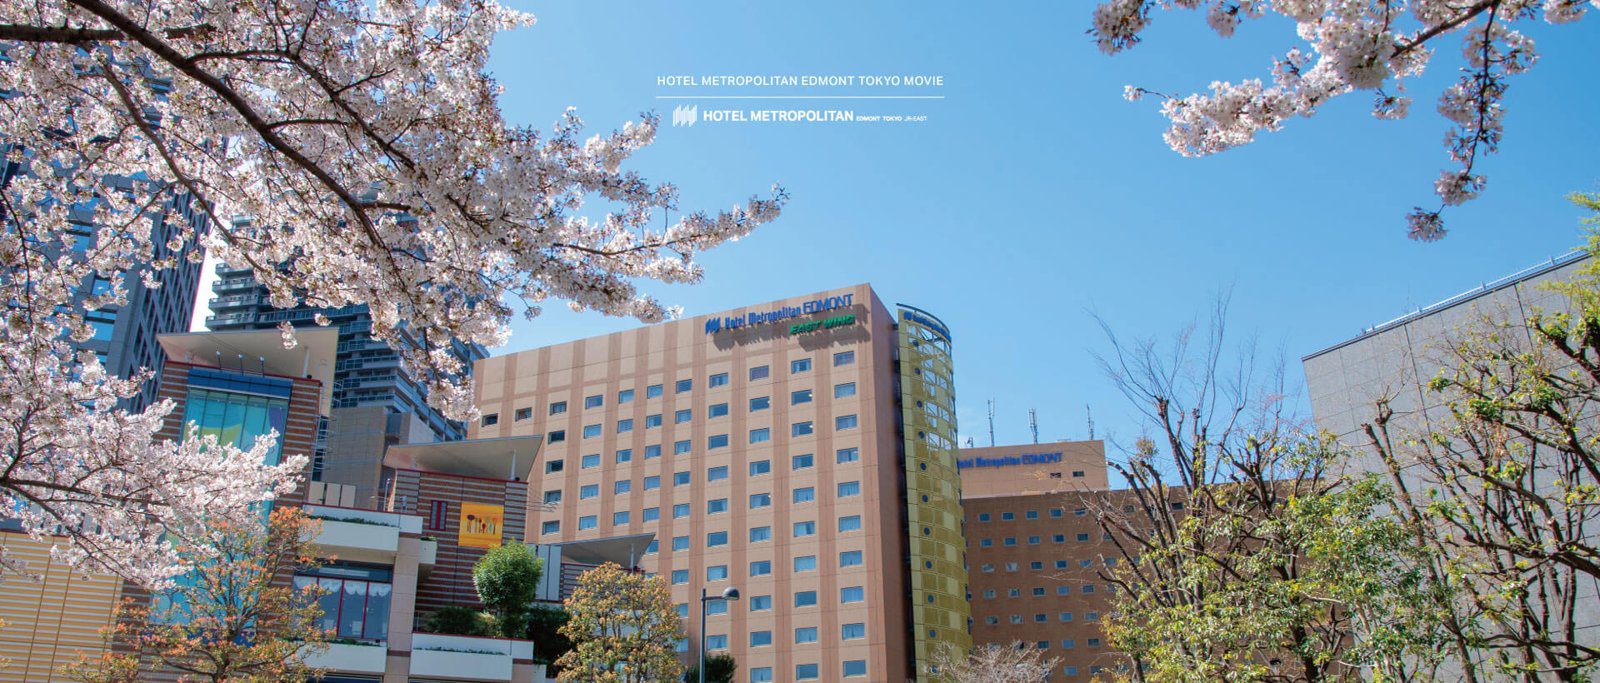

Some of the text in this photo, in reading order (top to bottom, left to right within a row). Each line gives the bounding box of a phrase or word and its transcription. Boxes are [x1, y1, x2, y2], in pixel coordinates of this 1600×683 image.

[724, 294, 854, 330] Hotel Metropolitan EDMONT
[790, 315, 855, 335] EAST WING
